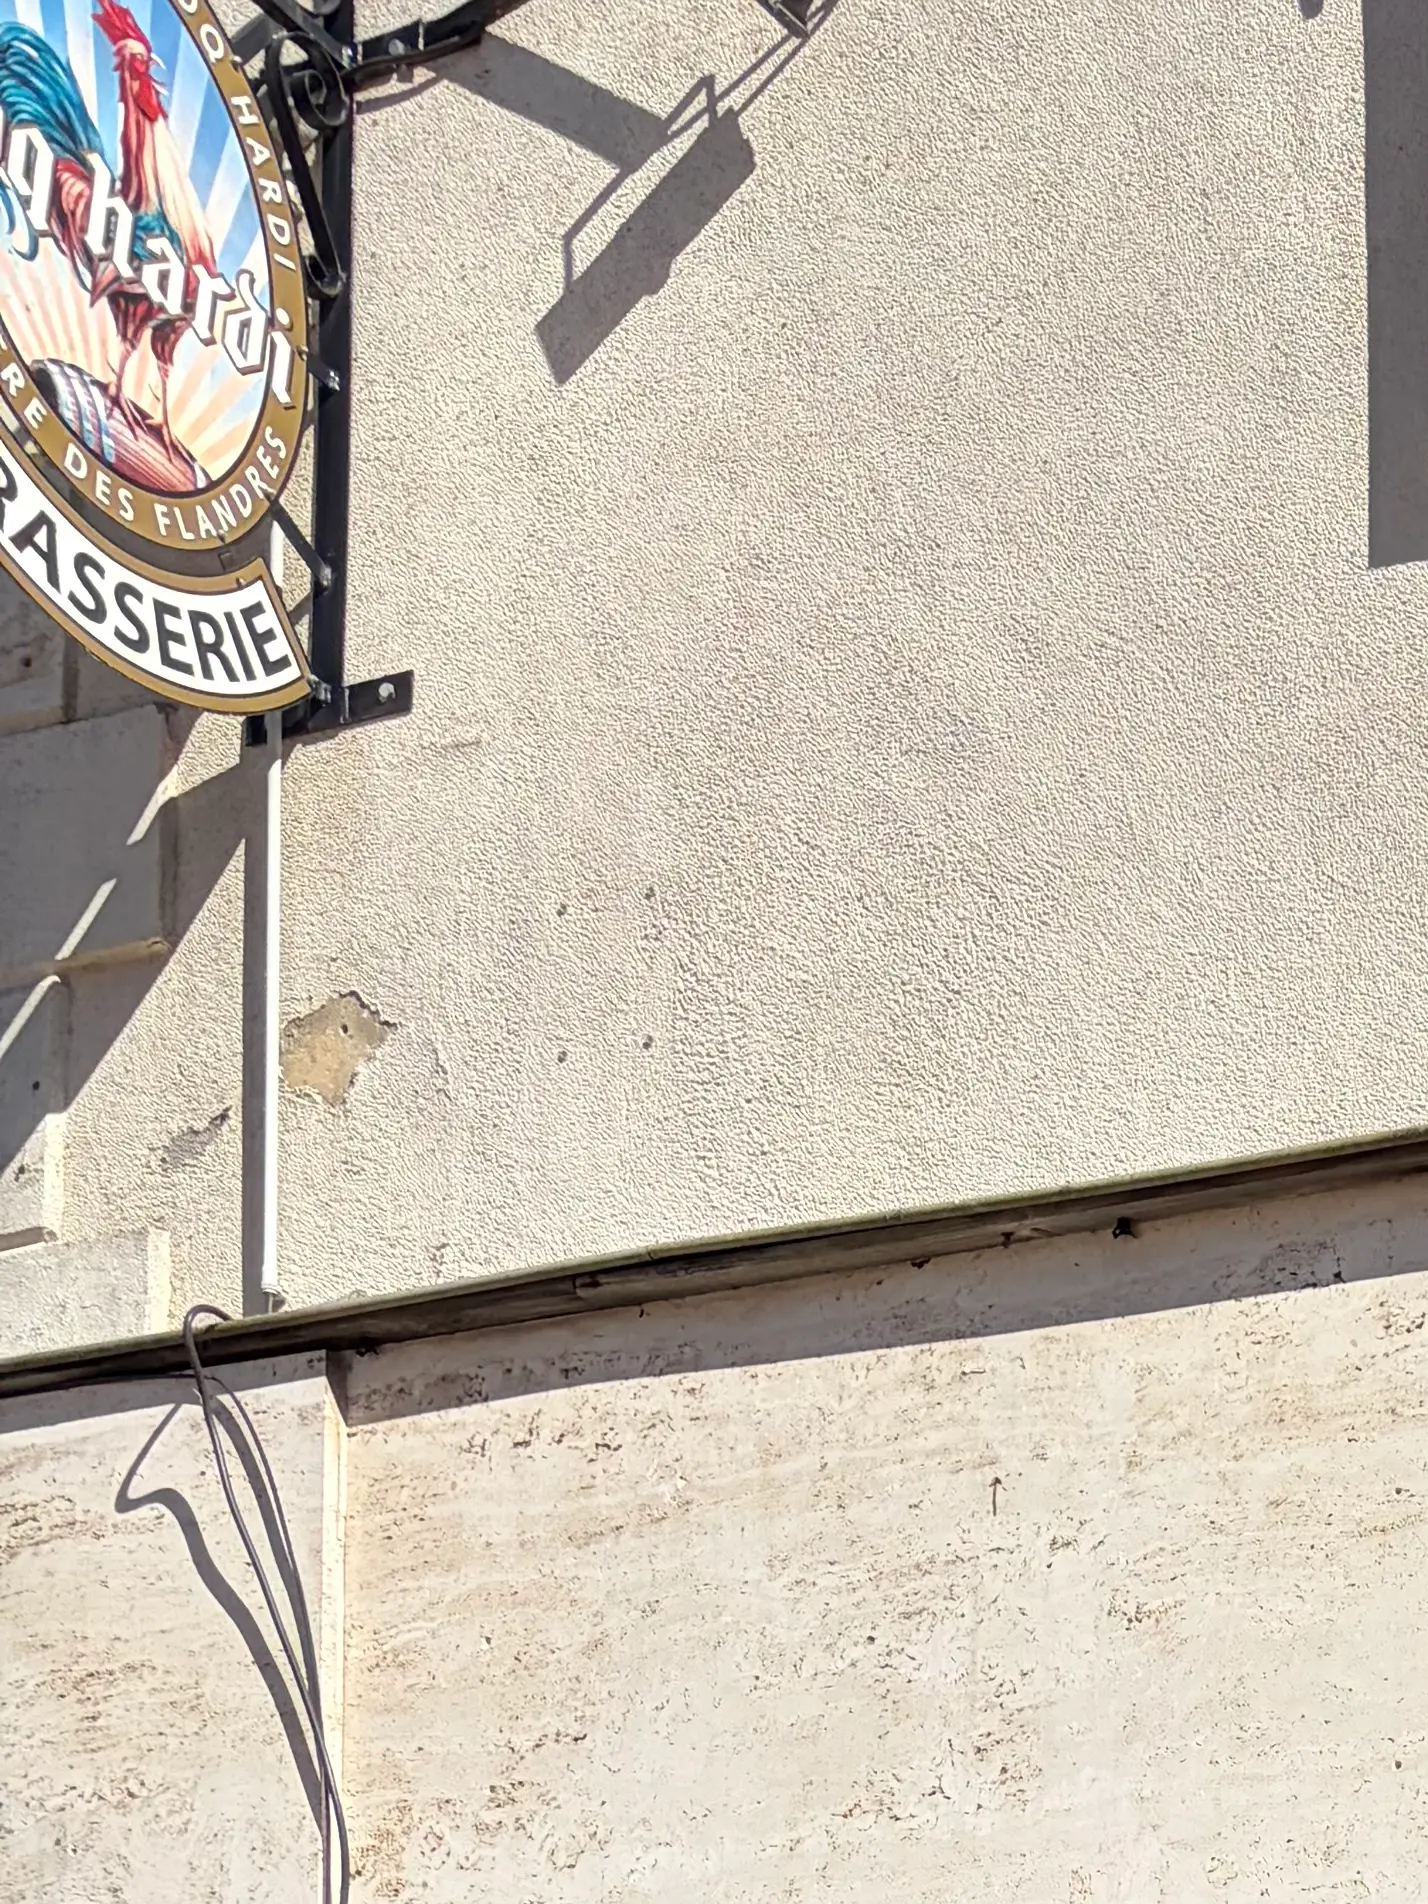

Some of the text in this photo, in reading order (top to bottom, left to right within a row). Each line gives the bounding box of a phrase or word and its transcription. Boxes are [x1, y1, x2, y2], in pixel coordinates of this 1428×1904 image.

[230, 95, 297, 272] HARDI
[0, 335, 287, 541] RE DES FLANDRES
